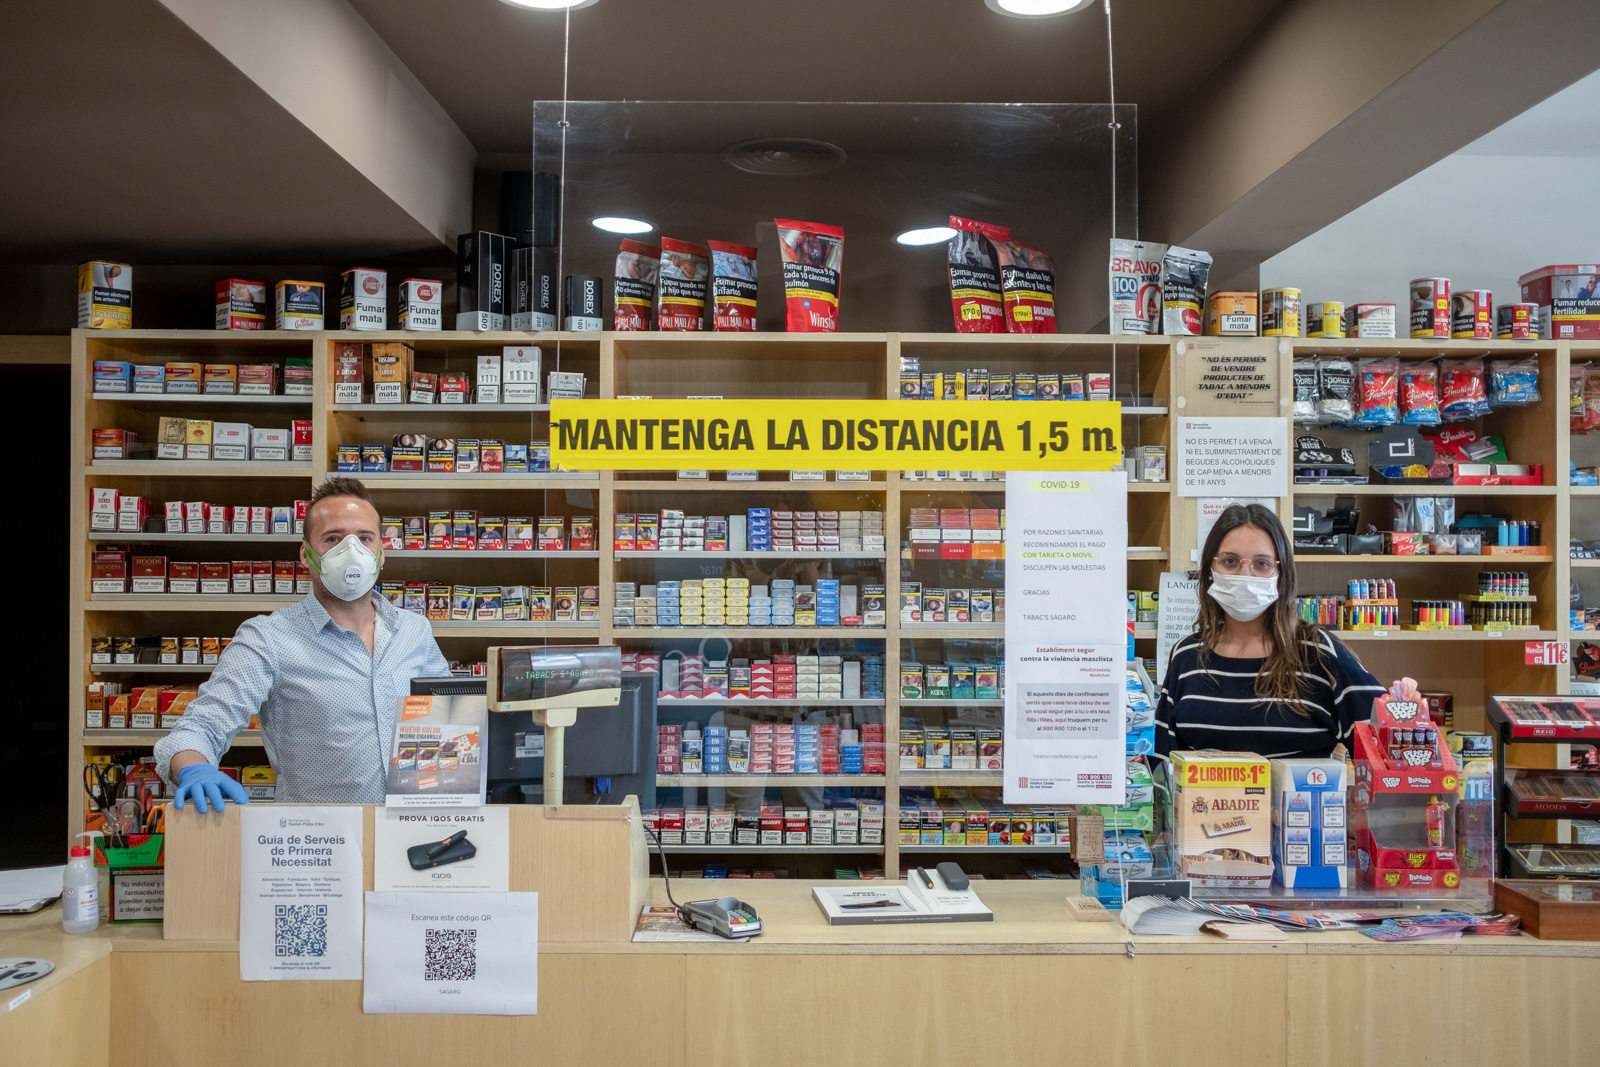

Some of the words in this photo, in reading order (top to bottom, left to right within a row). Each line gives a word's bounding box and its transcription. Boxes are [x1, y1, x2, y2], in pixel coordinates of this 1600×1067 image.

[803, 264, 823, 273] provoca
[1112, 258, 1162, 274] BRAVO
[784, 271, 799, 279] cada
[809, 273, 828, 283] cánceres
[492, 263, 501, 304] DOREX
[785, 280, 809, 288] pulmón
[1114, 277, 1137, 293] 100
[584, 280, 594, 314] DOREX
[356, 302, 385, 313] Fumar
[410, 306, 440, 316] Fumar
[359, 314, 382, 323] mata
[413, 317, 436, 325] mata
[810, 311, 836, 327] Winston
[559, 419, 754, 450] MANTENGA
[767, 419, 809, 450] LA
[823, 420, 1004, 451] DISTANCIA
[1017, 420, 1069, 458] 1,5
[1083, 427, 1113, 451] m
[1221, 458, 1276, 466] ALCOHÒLIQUES
[1041, 481, 1080, 489] COVID-19
[1547, 643, 1559, 664] 11
[1386, 701, 1418, 713] PUSH
[1396, 708, 1414, 720] POP
[1188, 766, 1198, 783] 2
[1201, 767, 1245, 781] LIBRITOS
[1312, 772, 1322, 783] 1€
[1212, 799, 1259, 810] ABADIE
[1222, 820, 1246, 830] ABADIE
[258, 835, 284, 845] Guia
[287, 835, 301, 844] de
[304, 835, 345, 845] Serveis
[270, 846, 285, 856] de
[288, 846, 332, 856] Primera
[272, 857, 332, 867] Necessitat
[456, 915, 479, 923] código
